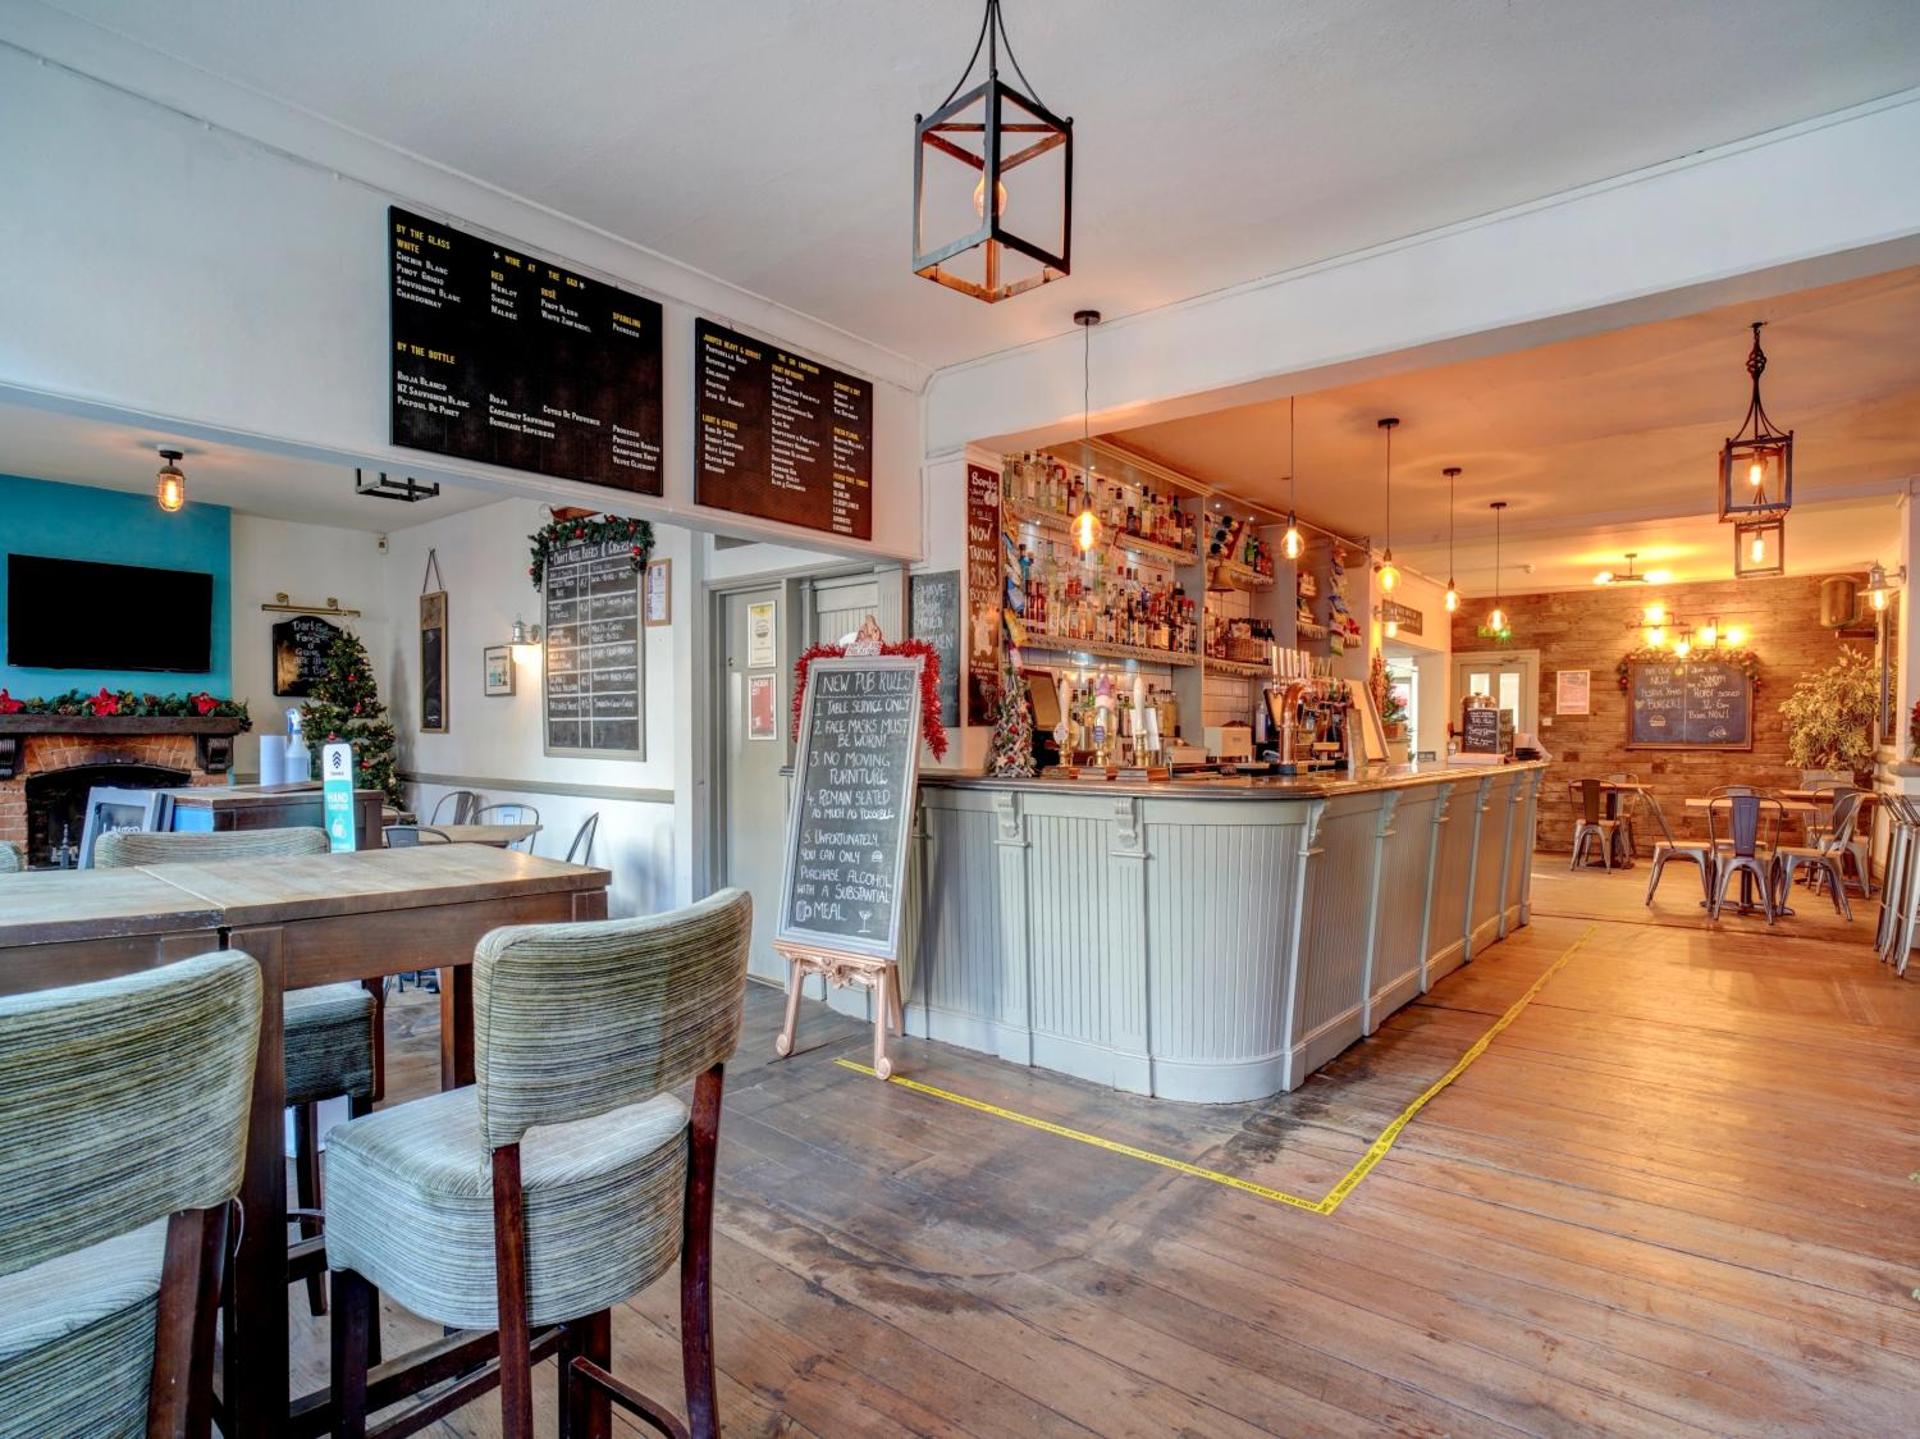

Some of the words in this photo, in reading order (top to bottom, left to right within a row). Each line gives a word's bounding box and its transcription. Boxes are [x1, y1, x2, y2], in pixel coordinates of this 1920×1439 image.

[396, 224, 406, 234] BY
[410, 228, 424, 241] THE
[428, 234, 450, 250] GLASS
[396, 238, 420, 254] WHITE
[490, 270, 504, 282] RED
[504, 255, 521, 268] WINE
[528, 263, 536, 272] AT
[549, 270, 560, 282] THE
[397, 341, 407, 352] BY
[411, 344, 424, 356] THE
[428, 350, 456, 364] BOTTLE
[397, 383, 408, 394] NZ
[970, 523, 994, 542] NOW
[969, 545, 997, 562] TAKING
[822, 674, 850, 693] NEW
[855, 672, 876, 694] PUB
[880, 671, 912, 692] RULES
[828, 700, 849, 716] TABLE
[852, 700, 882, 713] SERVICE
[885, 698, 910, 712] ONLY
[825, 720, 846, 734] FACE
[848, 719, 878, 734] MASKS
[880, 718, 912, 735] MUST
[838, 734, 852, 748] BE
[854, 734, 887, 748] WORN!
[824, 751, 840, 766] NO
[845, 752, 890, 768] MOVING
[830, 768, 888, 786] FURNITURE
[818, 788, 852, 806] REMAIN
[855, 789, 890, 806] SEATED
[824, 808, 844, 819] MUCH
[800, 848, 816, 861] YOU
[820, 849, 835, 861] CAN
[840, 849, 860, 864] ONLY
[800, 864, 840, 881] PURCHASE
[847, 868, 892, 889] ALCOHOL
[796, 884, 815, 896] WITH
[822, 884, 829, 897] A
[834, 884, 890, 904] SUBSTANTIAL
[814, 901, 848, 922] MEAL
